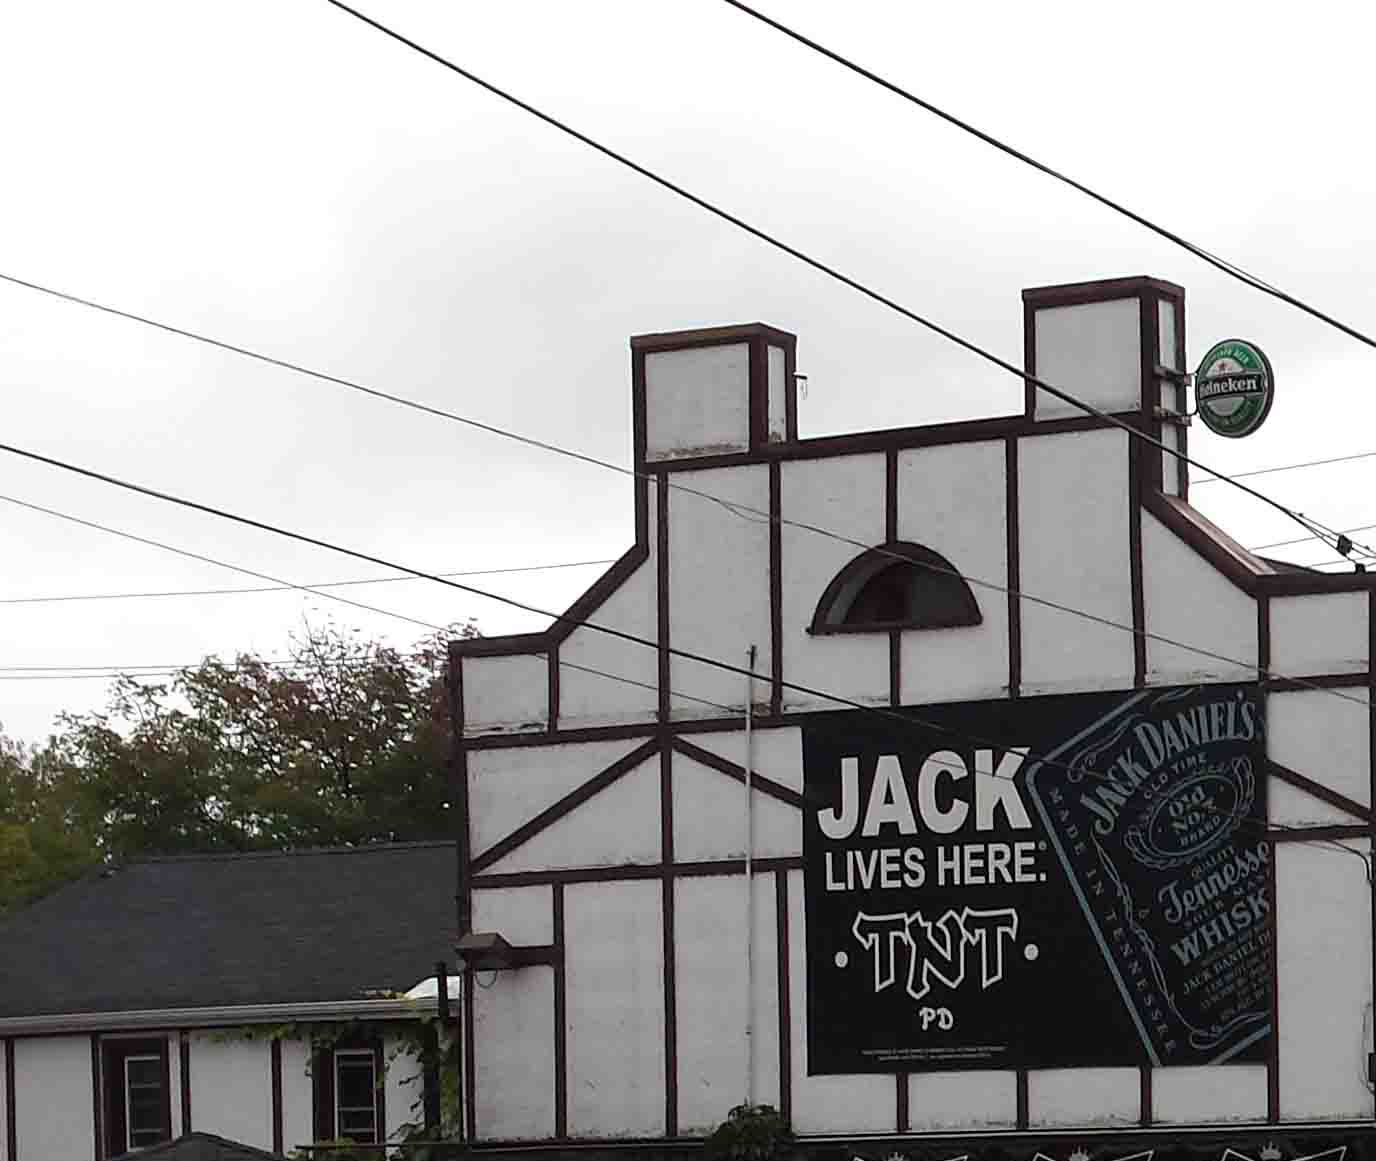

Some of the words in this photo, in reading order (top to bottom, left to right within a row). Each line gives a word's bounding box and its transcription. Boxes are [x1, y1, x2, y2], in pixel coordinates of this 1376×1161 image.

[817, 746, 1032, 840] JACK
[1080, 746, 1150, 835] JACK
[1134, 689, 1256, 769] DANIEL'S
[825, 847, 926, 891] LIVES
[852, 906, 1018, 999] TNT
[919, 1007, 954, 1031] PD
